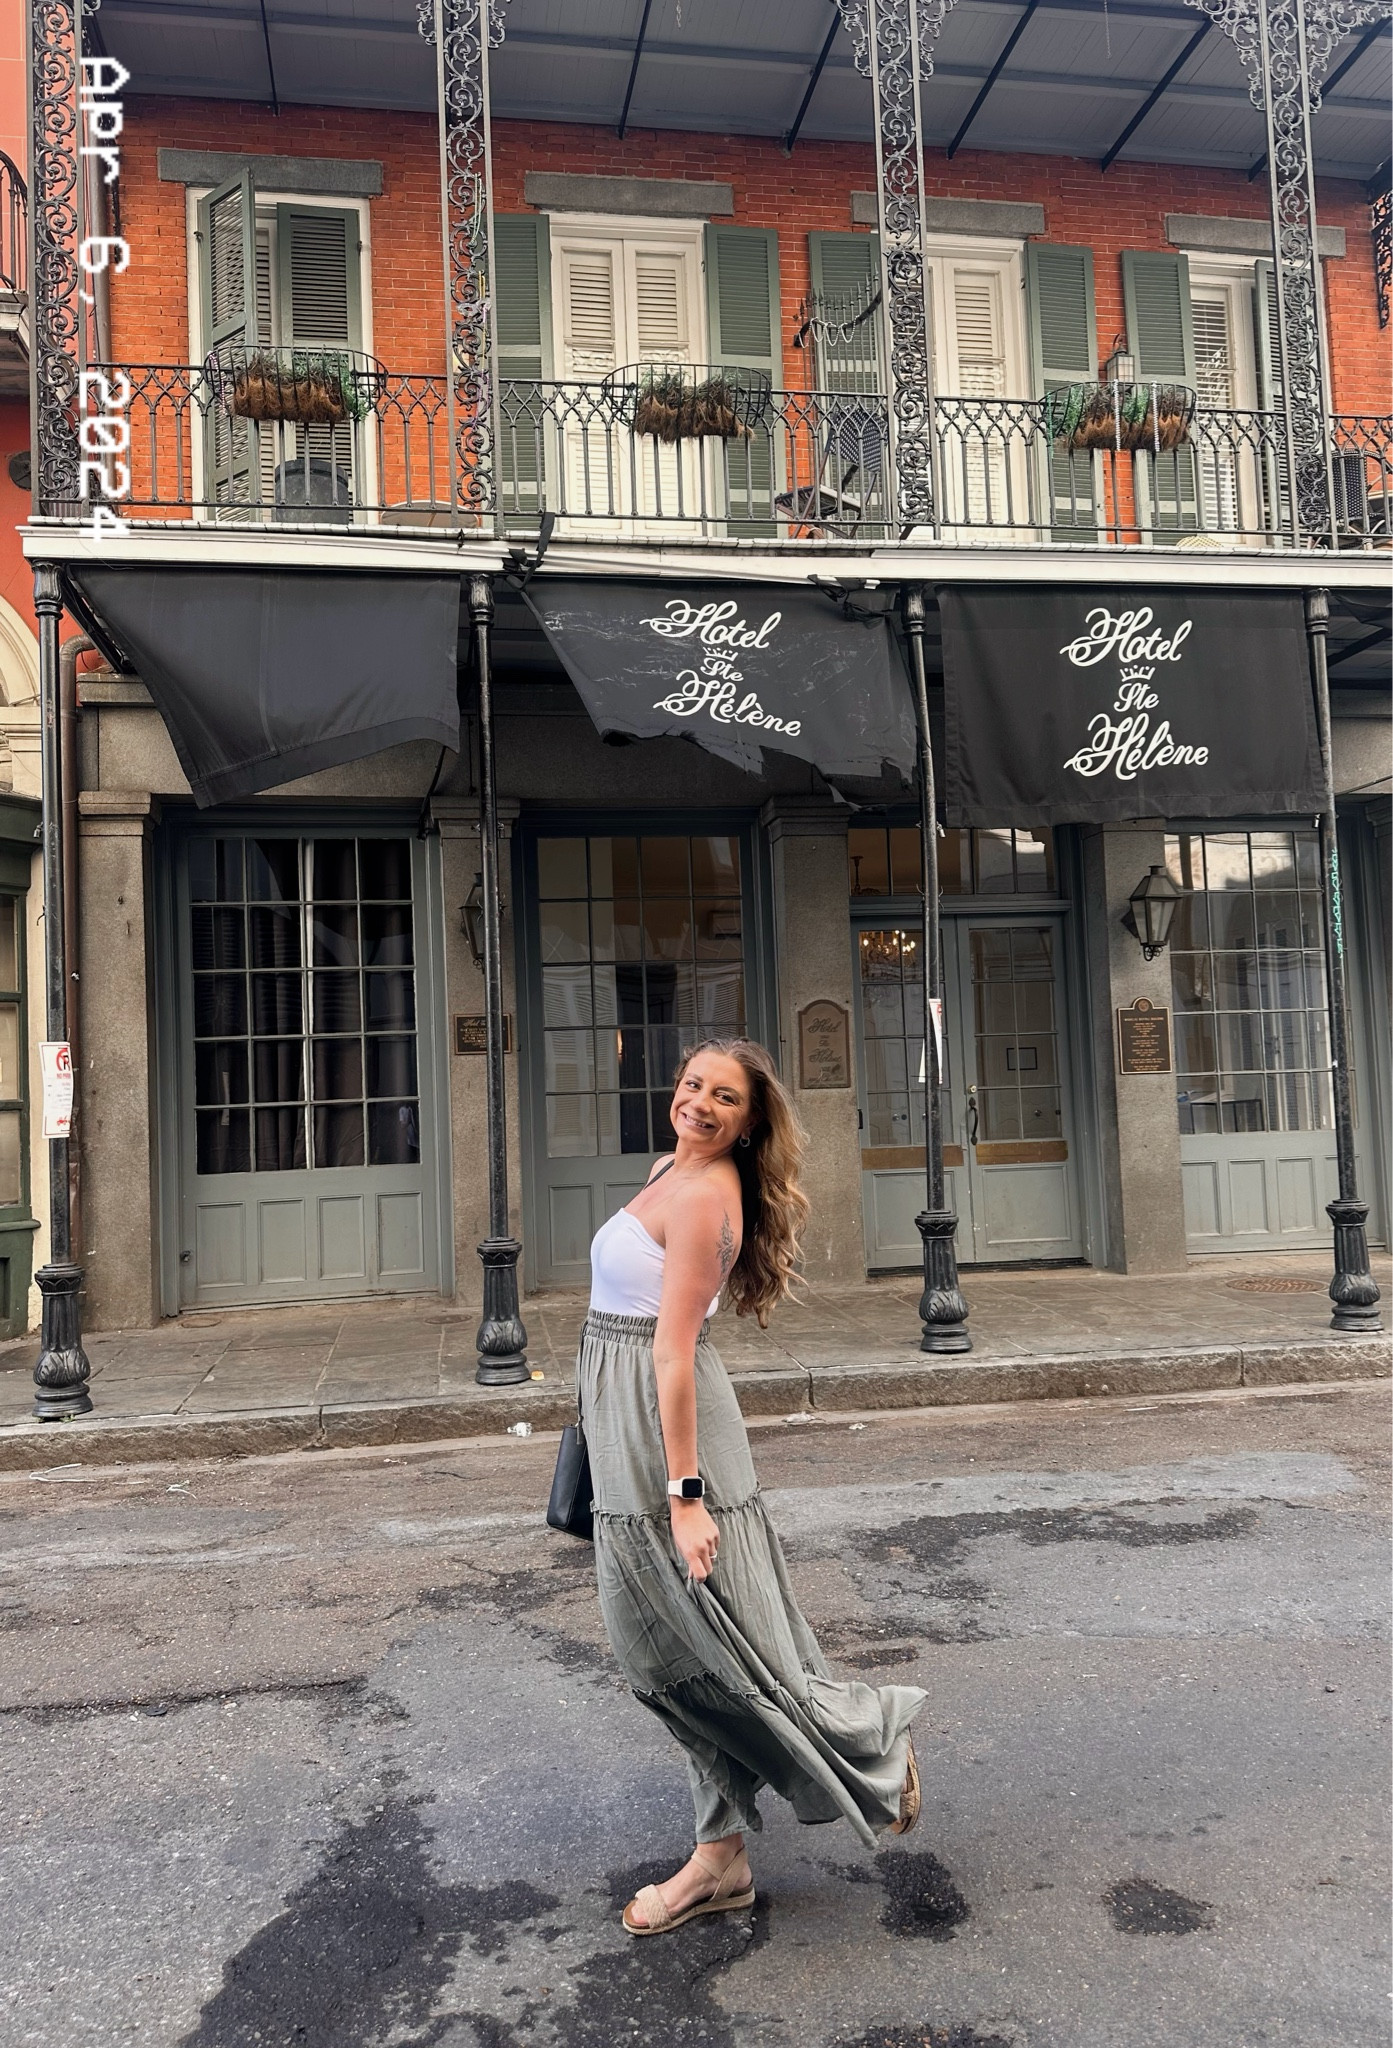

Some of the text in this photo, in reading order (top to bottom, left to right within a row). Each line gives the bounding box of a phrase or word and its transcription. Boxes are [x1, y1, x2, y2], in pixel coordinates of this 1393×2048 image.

[639, 599, 782, 648] Hotel
[1059, 606, 1193, 667] Hotel
[700, 657, 744, 682] Ste
[1113, 682, 1159, 712] Ste
[652, 669, 802, 737] Hélène
[1063, 712, 1209, 780] Hélène
